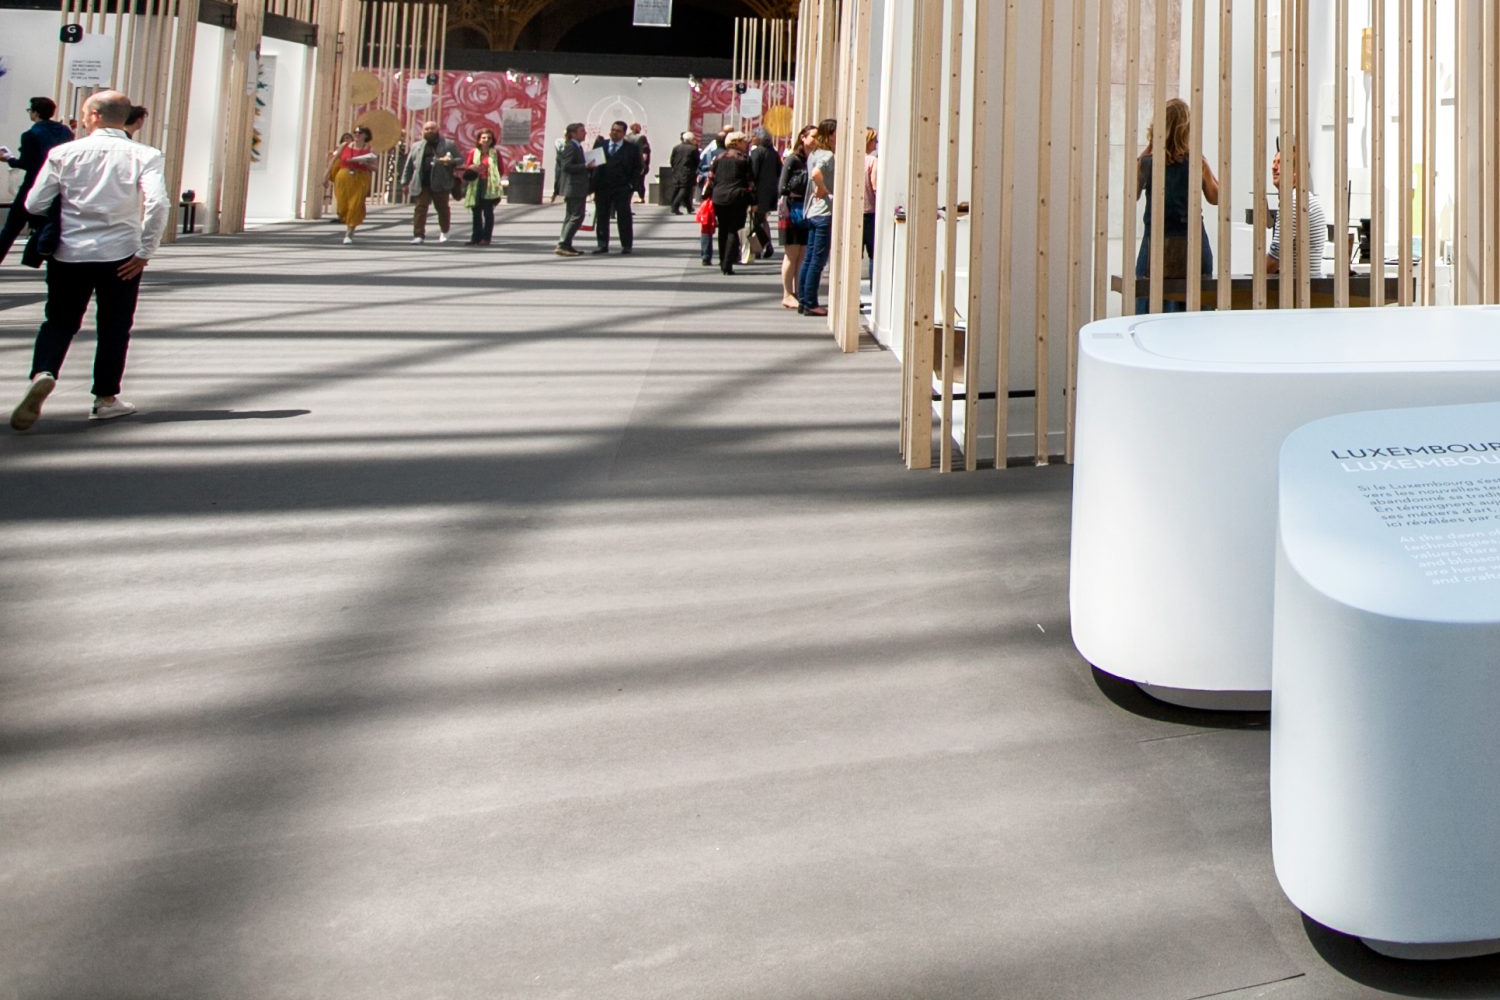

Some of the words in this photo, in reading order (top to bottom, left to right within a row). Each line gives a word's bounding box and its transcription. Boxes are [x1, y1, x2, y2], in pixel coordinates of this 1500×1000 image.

[67, 25, 77, 34] G
[1389, 480, 1473, 489] Luxembourg
[1418, 486, 1480, 494] nouvelles
[1370, 495, 1444, 504] abandonné
[1396, 501, 1475, 510] témoignent
[1406, 517, 1464, 525] révélées
[1418, 533, 1442, 541] the
[1418, 558, 1446, 567] and
[1451, 565, 1486, 573] here
[1431, 575, 1459, 584] and
